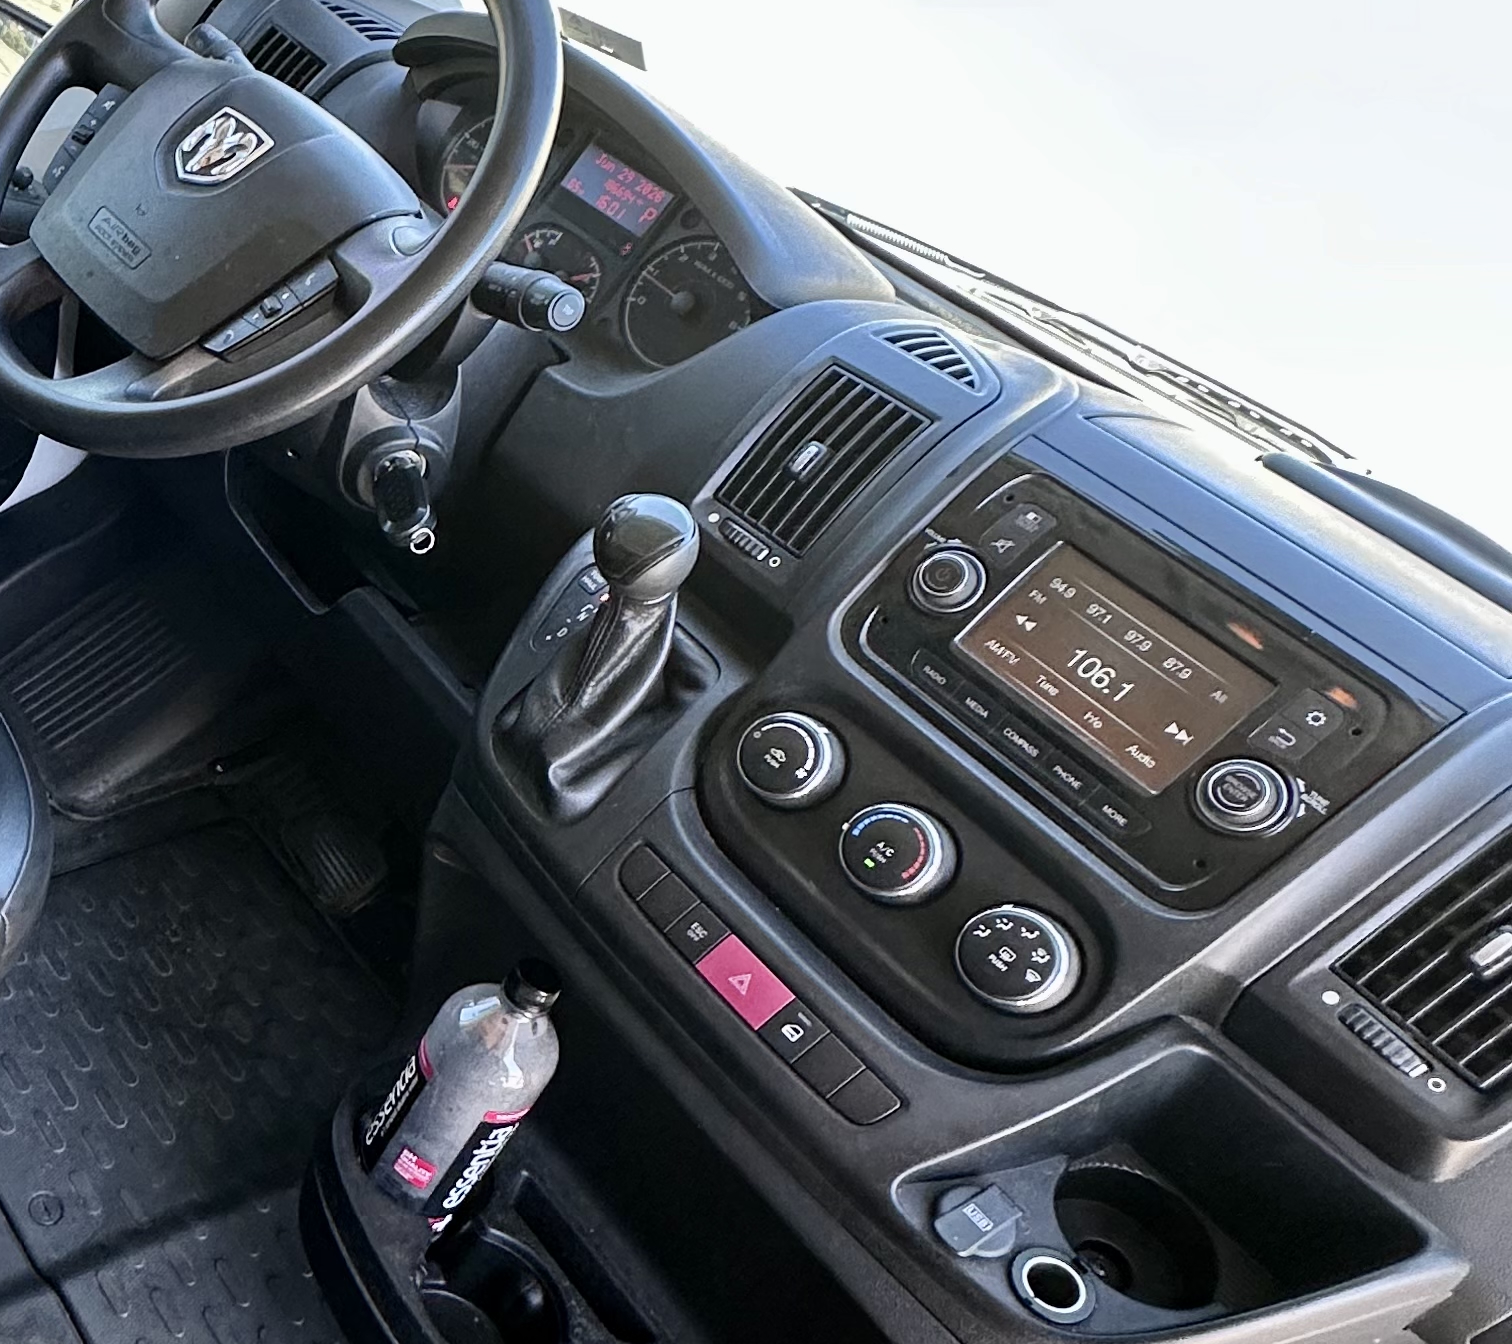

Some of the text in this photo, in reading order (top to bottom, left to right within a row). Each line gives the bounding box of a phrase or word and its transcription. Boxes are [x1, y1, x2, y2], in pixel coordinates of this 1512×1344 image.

[1028, 589, 1048, 605] FM
[1049, 577, 1077, 599] 94.9
[1086, 603, 1113, 624] 97.1
[1124, 630, 1153, 652] 97.9
[1162, 657, 1192, 679] 87.9
[923, 665, 947, 686] RADIO
[1066, 649, 1136, 702] 106.1
[965, 696, 989, 718] MEDIA
[1035, 674, 1060, 696] Tune
[1124, 744, 1156, 769] Audio
[1003, 727, 1040, 758] COMPASS
[1052, 764, 1084, 791] PHONE
[1102, 804, 1129, 828] MORE
[875, 840, 895, 857] A/C
[690, 921, 709, 940] ESC
[443, 1125, 515, 1209] essentia
